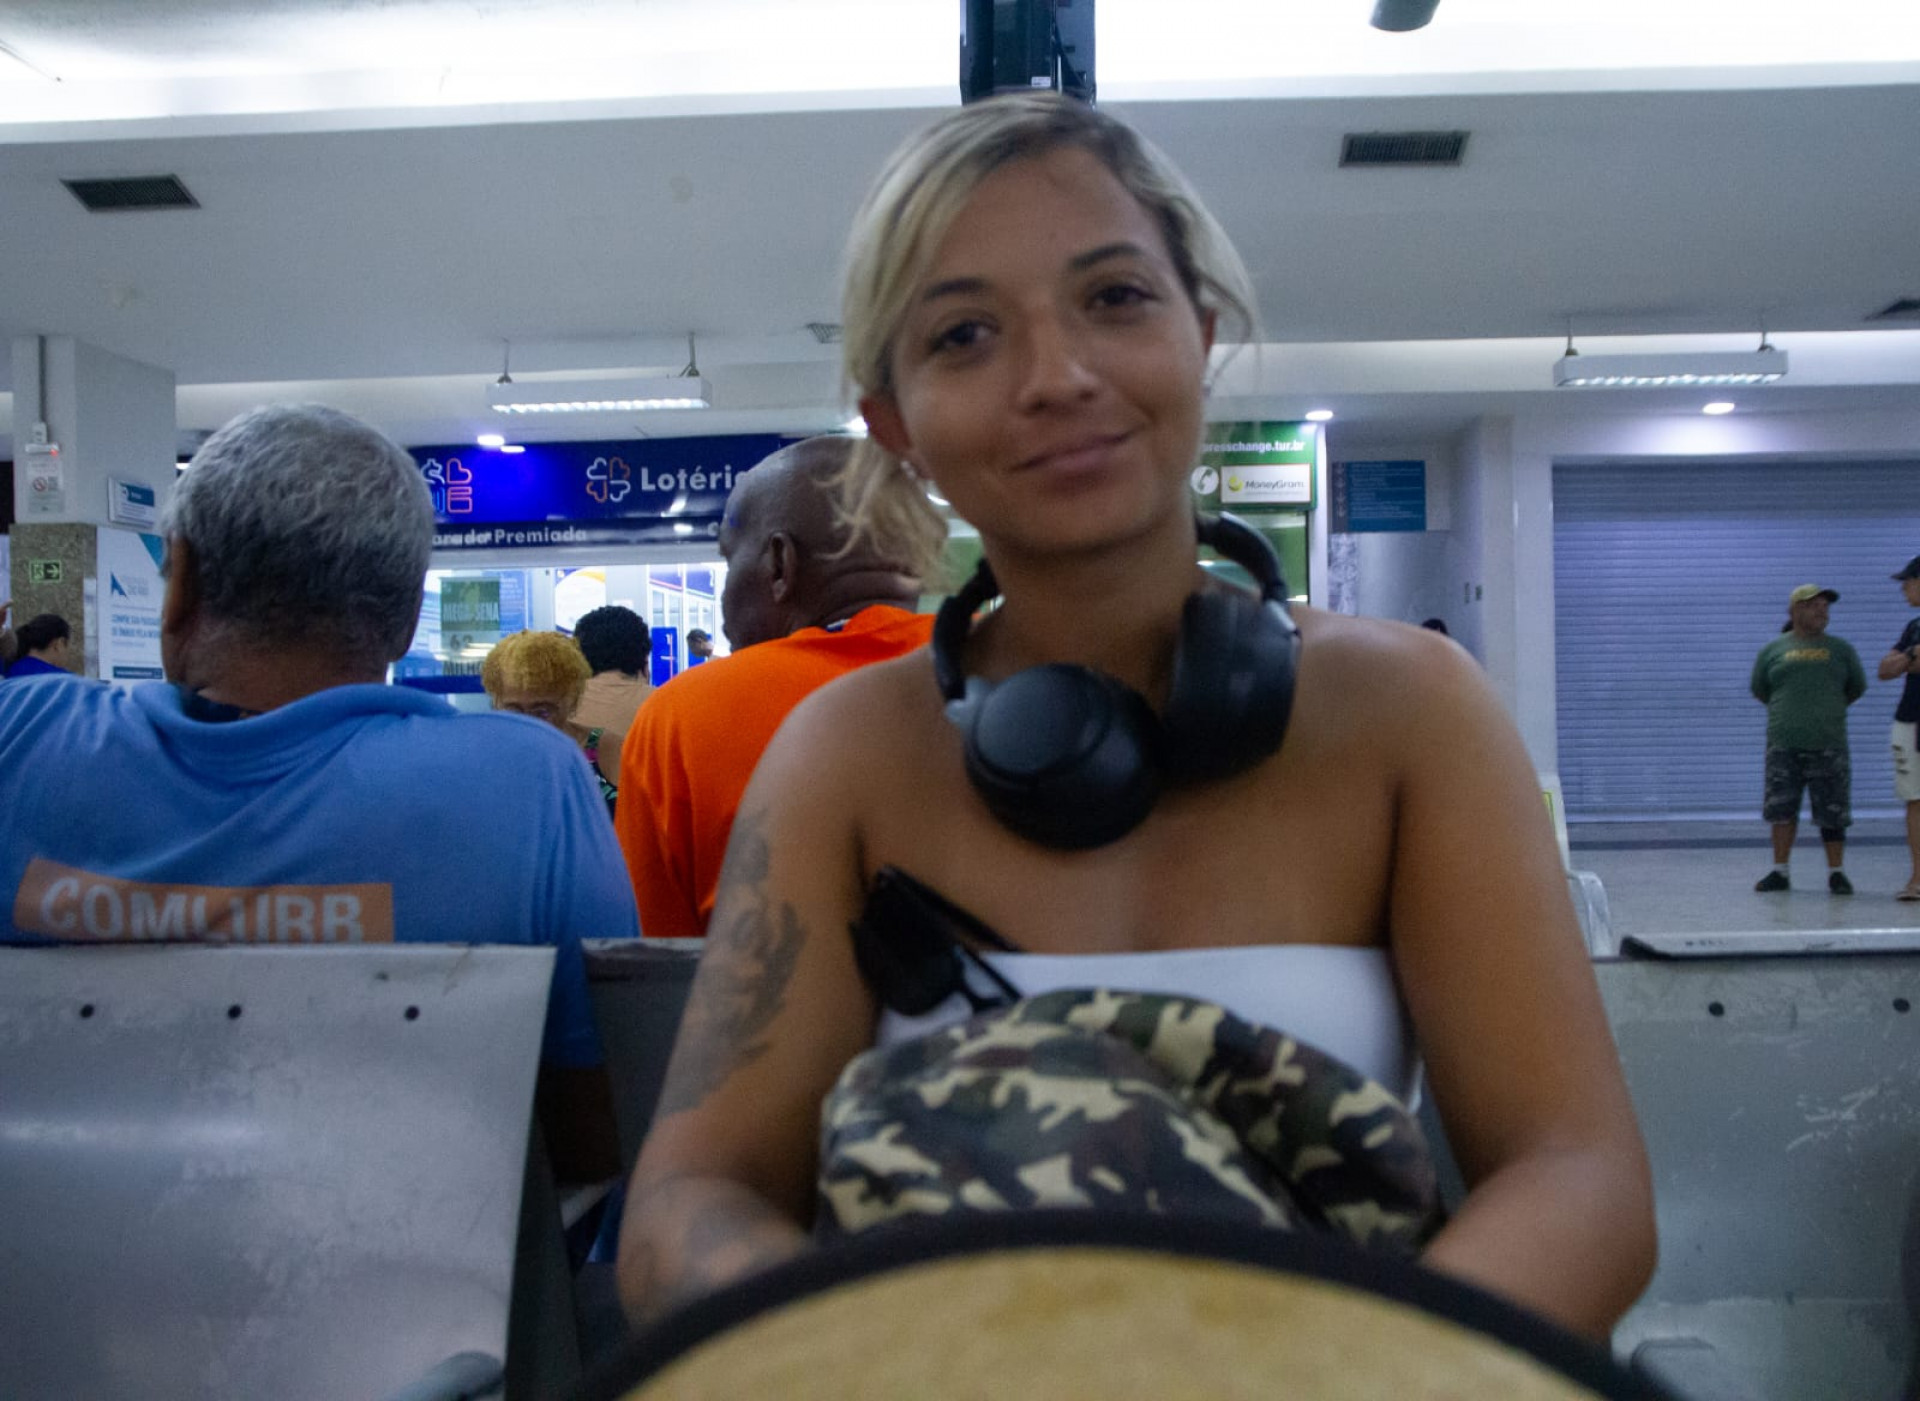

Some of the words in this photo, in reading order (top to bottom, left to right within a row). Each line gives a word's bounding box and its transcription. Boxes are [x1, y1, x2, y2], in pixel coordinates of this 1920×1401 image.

[1245, 480, 1304, 490] MoneyGram
[432, 528, 491, 546] arada
[494, 525, 587, 544] Premiada
